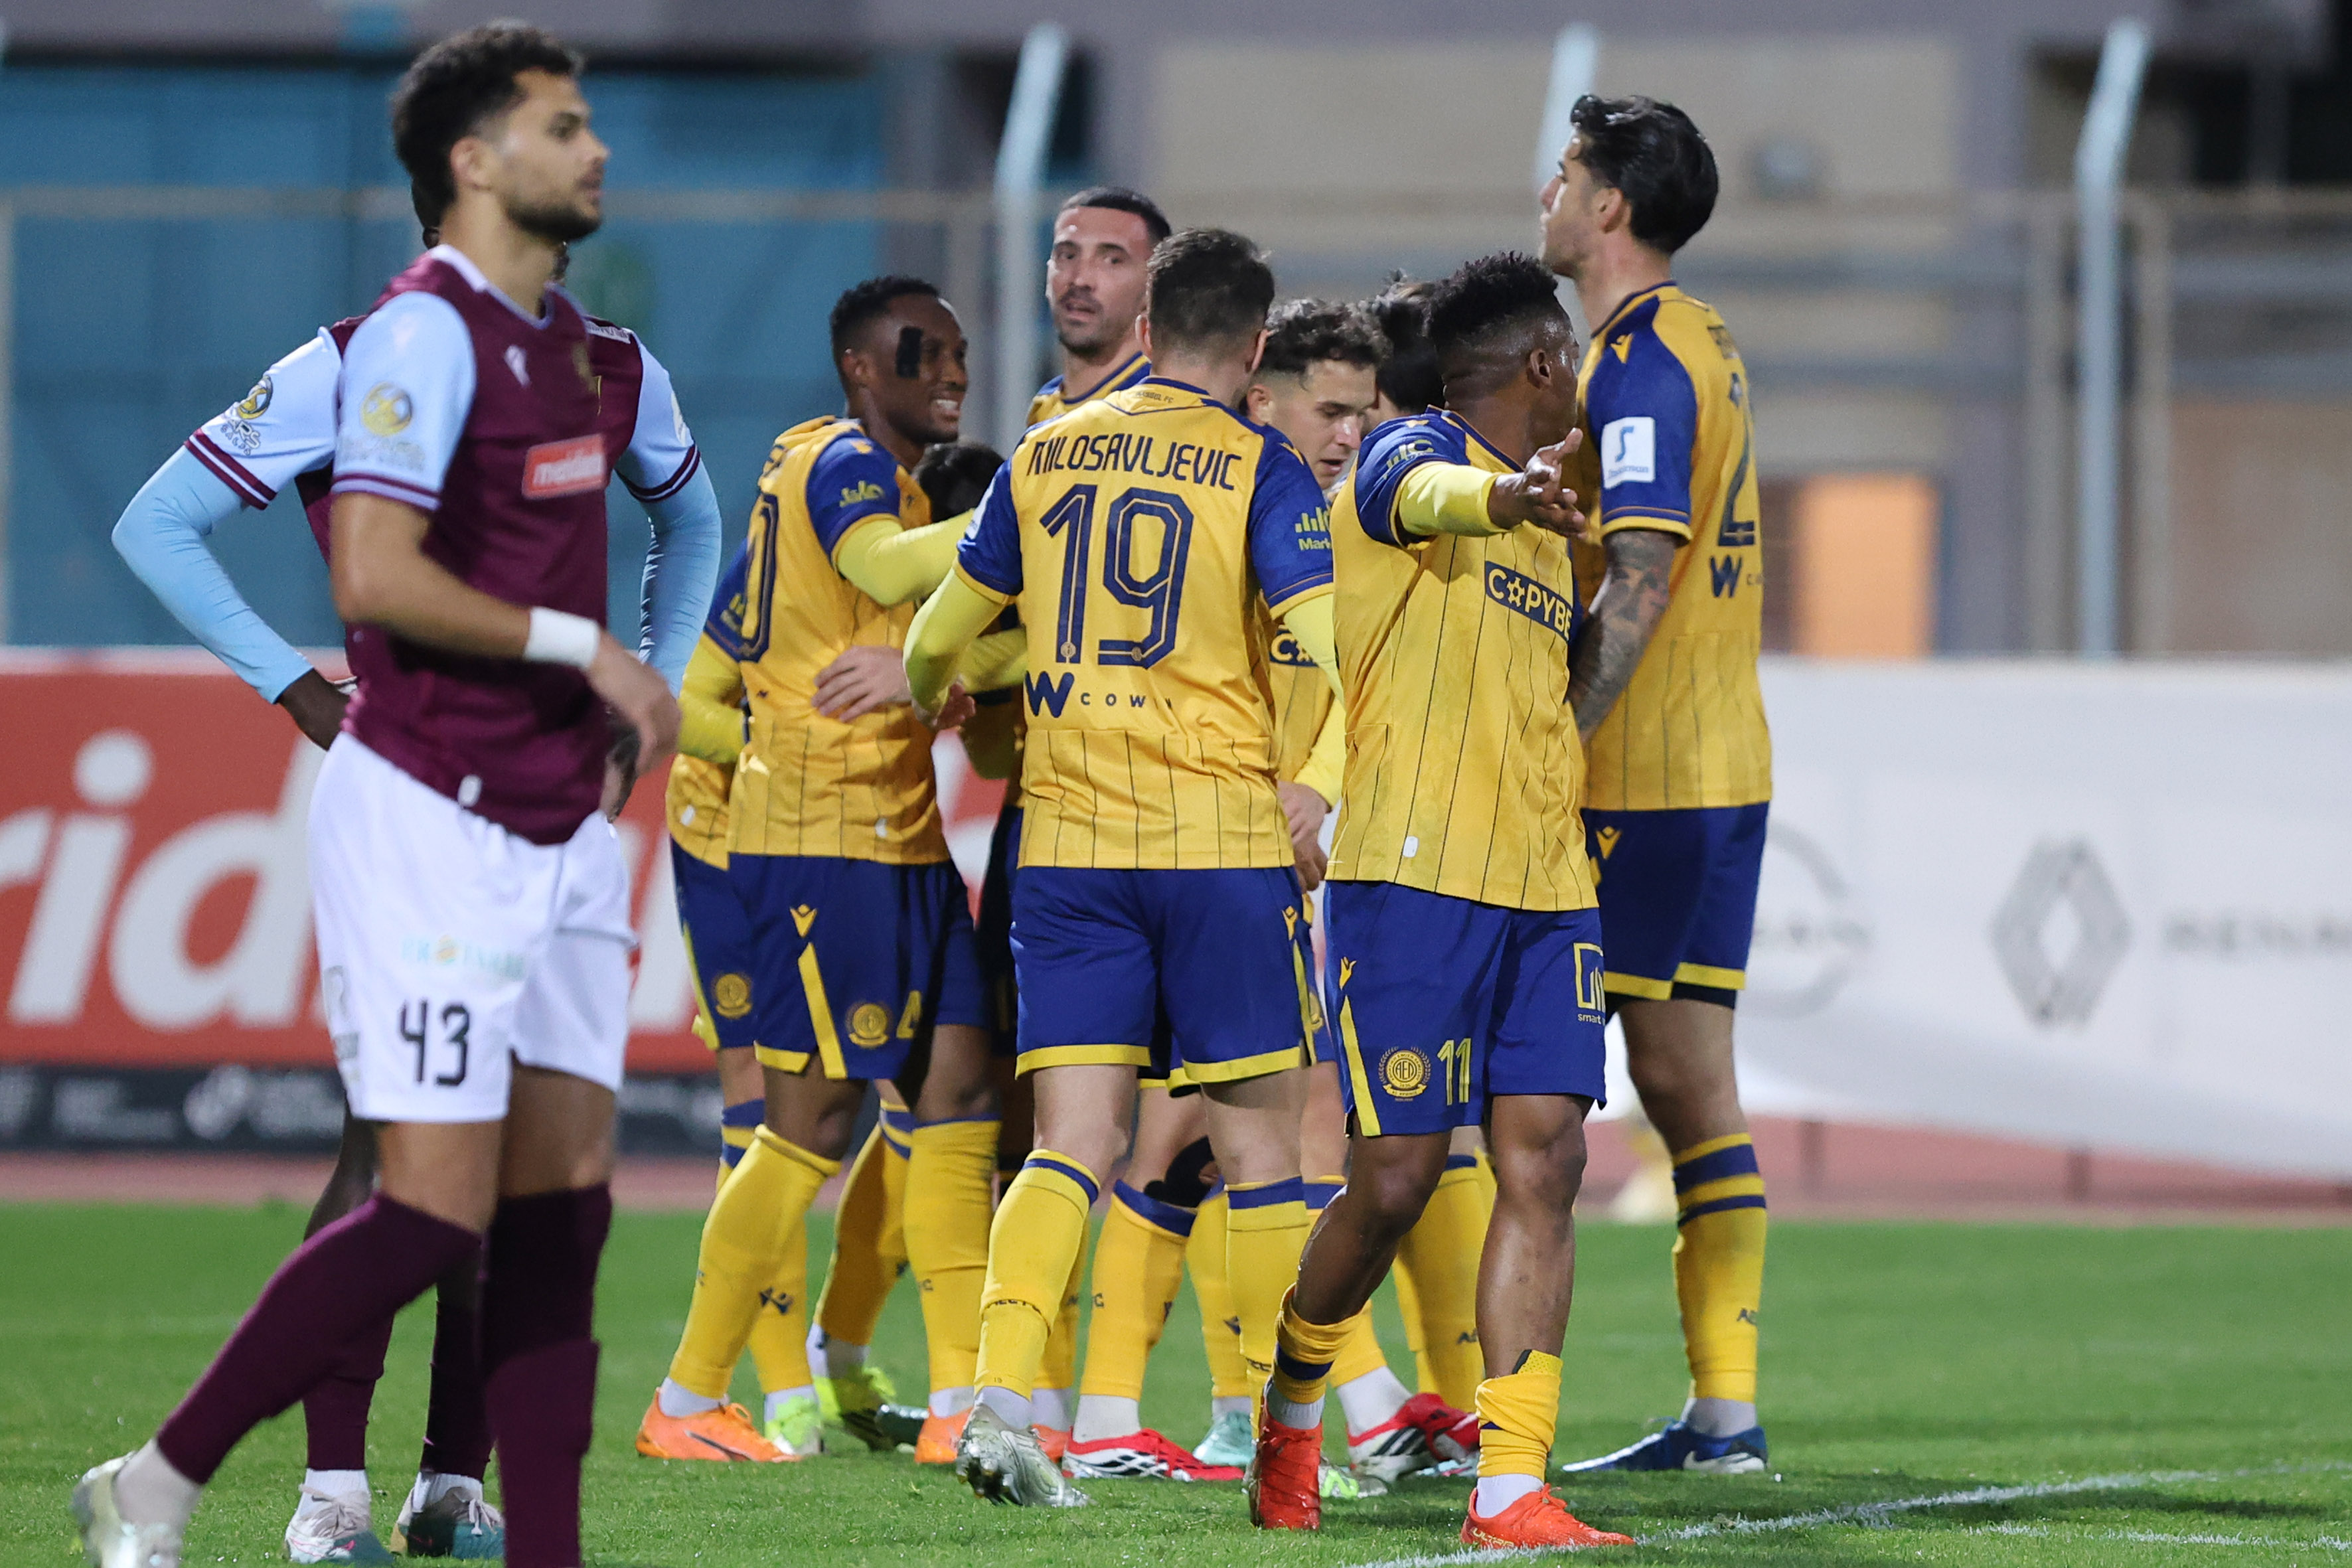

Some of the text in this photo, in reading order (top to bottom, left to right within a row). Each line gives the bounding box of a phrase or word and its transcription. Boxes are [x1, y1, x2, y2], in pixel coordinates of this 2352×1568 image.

[1026, 433, 1242, 491] MILOSAVLJEVIC
[1039, 483, 1194, 670] 19
[400, 998, 470, 1087] 43
[1577, 1013, 1601, 1025] smart
[1437, 1038, 1472, 1107] 11
